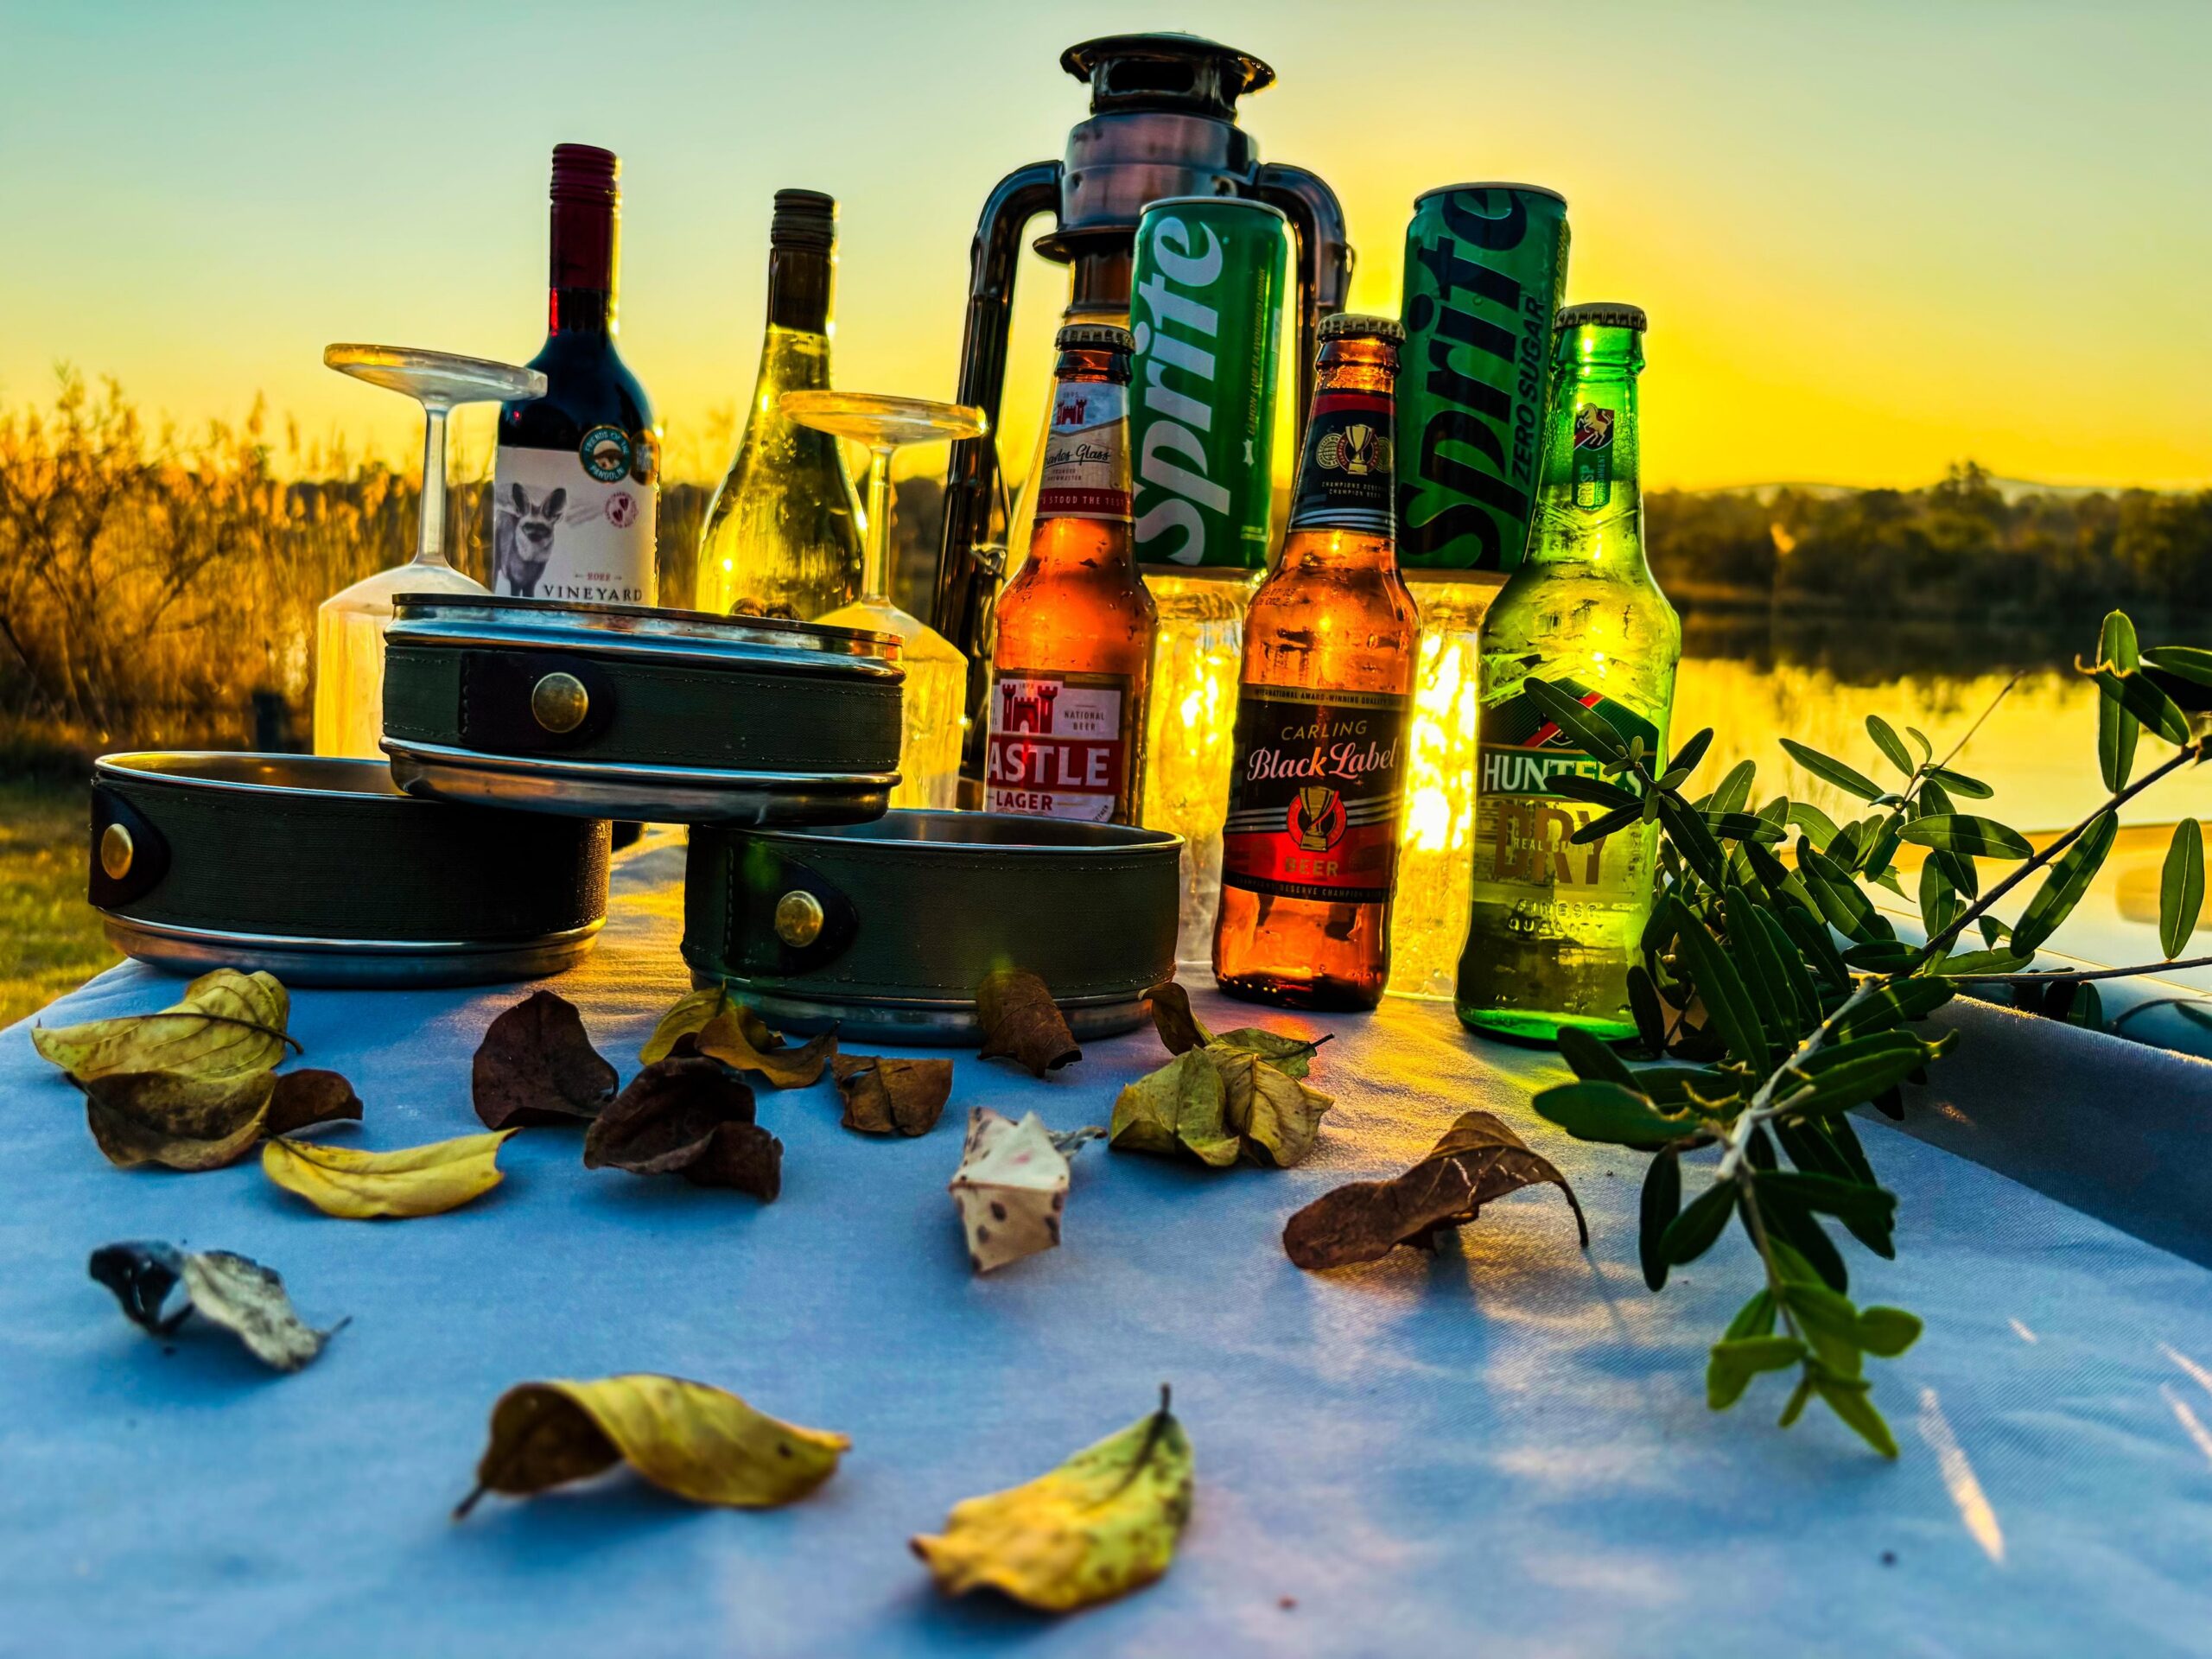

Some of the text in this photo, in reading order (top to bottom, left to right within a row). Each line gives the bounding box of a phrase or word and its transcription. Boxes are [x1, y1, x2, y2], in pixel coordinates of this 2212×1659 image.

[1399, 190, 1529, 569] Sprite
[1134, 216, 1231, 566] Sprite
[1511, 296, 1547, 488] ZERO SUGAR
[1083, 496, 1101, 505] THE
[587, 572, 612, 581] 2022
[543, 584, 642, 602] VINEYARD
[1064, 710, 1105, 721] NATIONAL
[1072, 721, 1096, 731] BEER
[1281, 721, 1368, 741] CARLING
[988, 741, 1110, 786] ASTLE
[1247, 737, 1398, 781] Black Label
[996, 791, 1053, 810] LAGER
[1495, 801, 1608, 886] DRY
[1513, 838, 1543, 851] REAL
[1285, 856, 1338, 877] BEER
